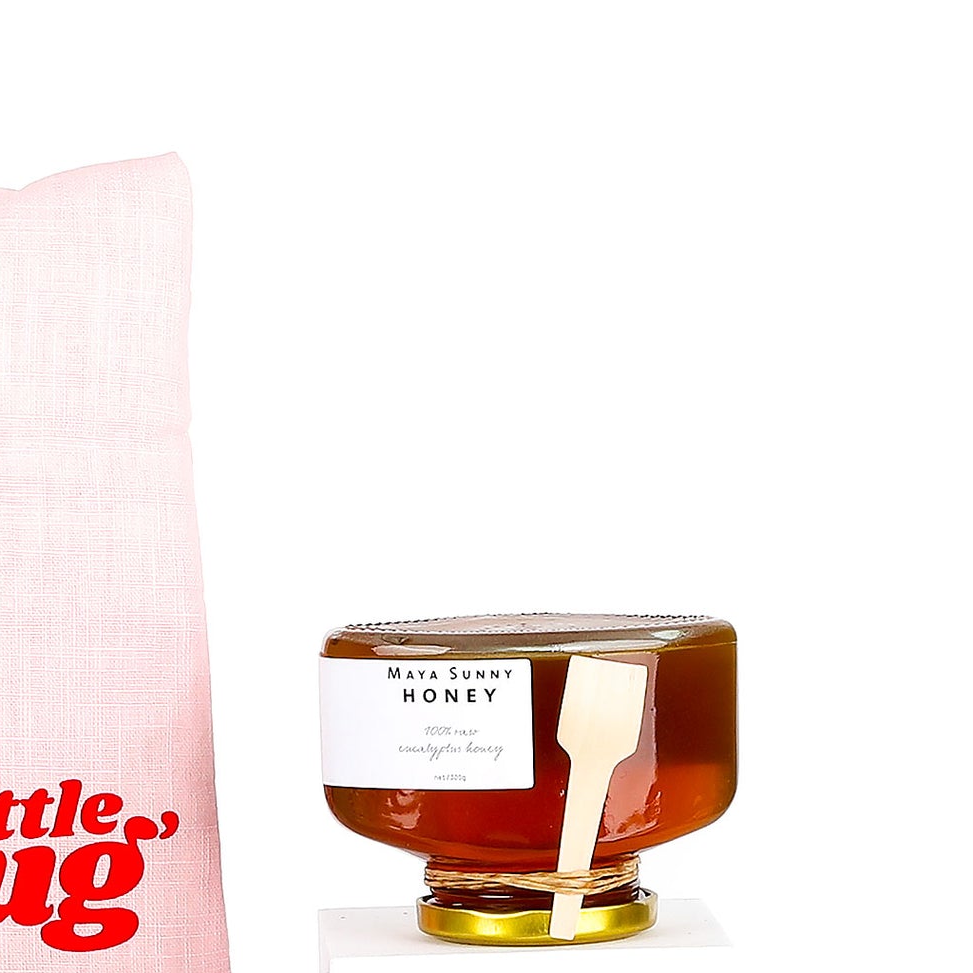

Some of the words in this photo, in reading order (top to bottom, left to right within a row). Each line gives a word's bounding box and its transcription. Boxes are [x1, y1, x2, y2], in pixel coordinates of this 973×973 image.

[403, 688, 497, 703] HONEY
[424, 726, 452, 737] 100%
[398, 743, 462, 762] eucalyptus
[465, 741, 504, 762] honey
